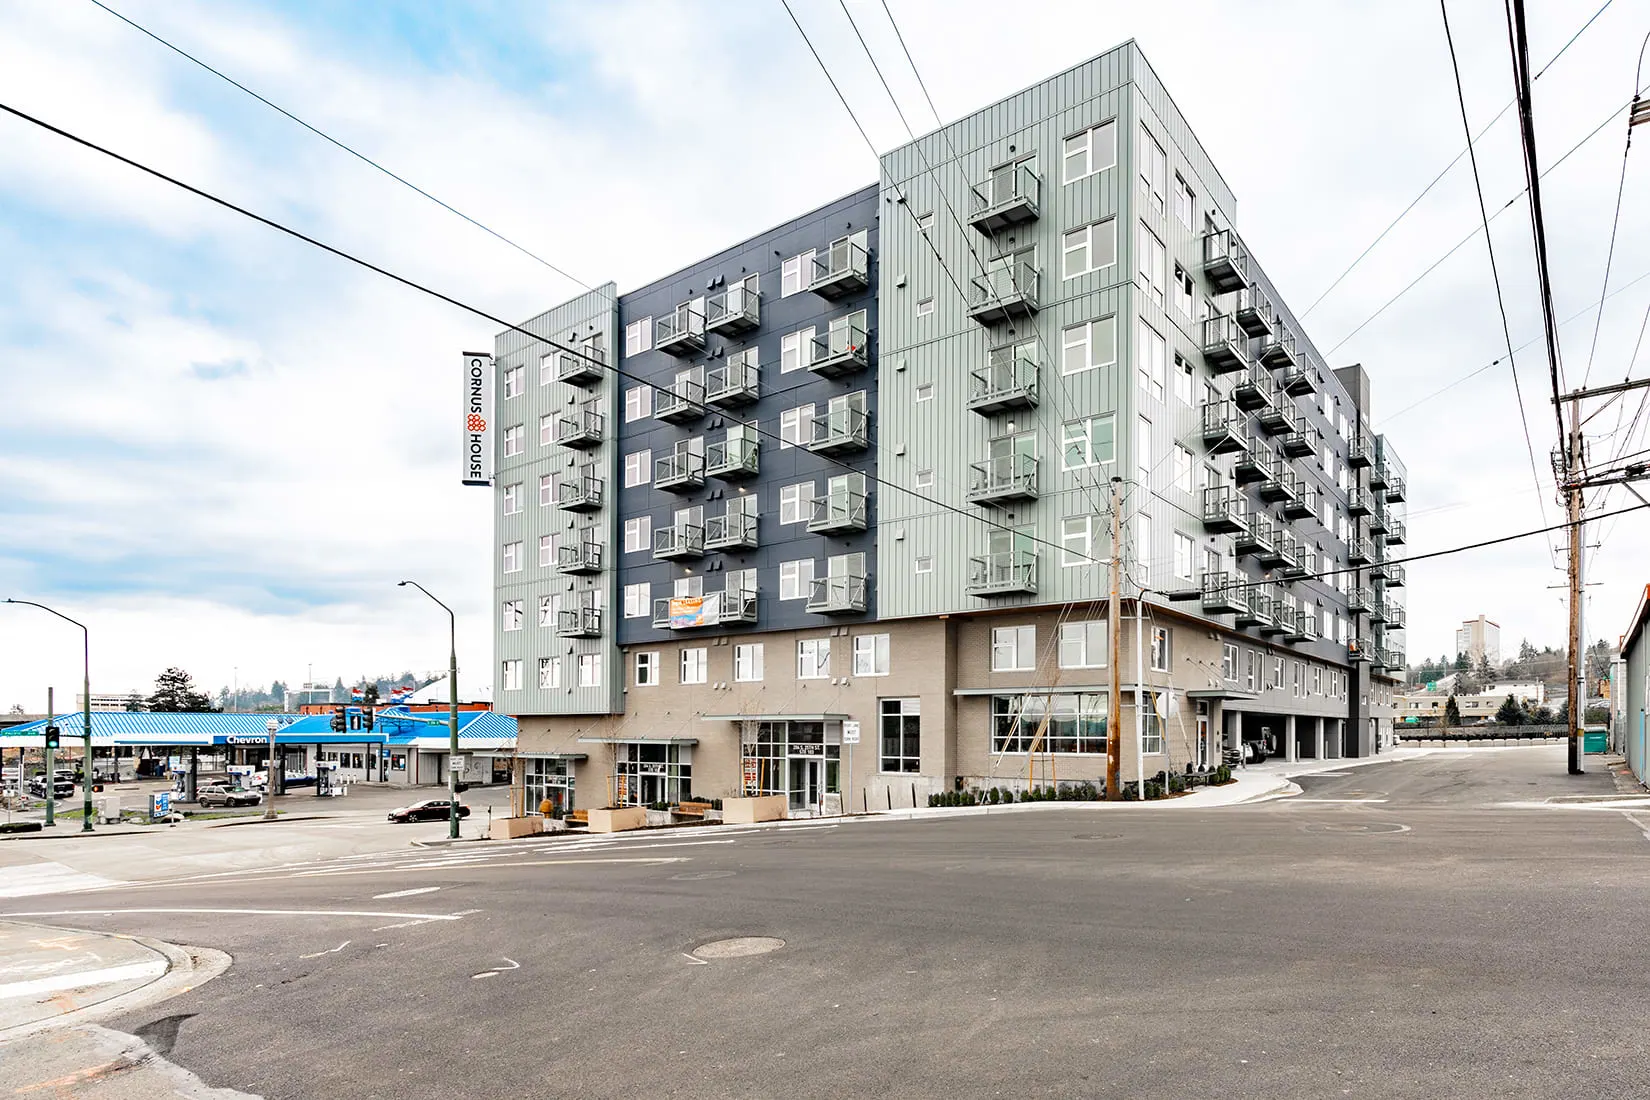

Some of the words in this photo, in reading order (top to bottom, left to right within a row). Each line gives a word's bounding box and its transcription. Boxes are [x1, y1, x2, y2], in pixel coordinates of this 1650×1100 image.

[471, 358, 482, 414] CORNUS
[470, 434, 482, 478] HOUSE
[226, 735, 268, 744] Chevron
